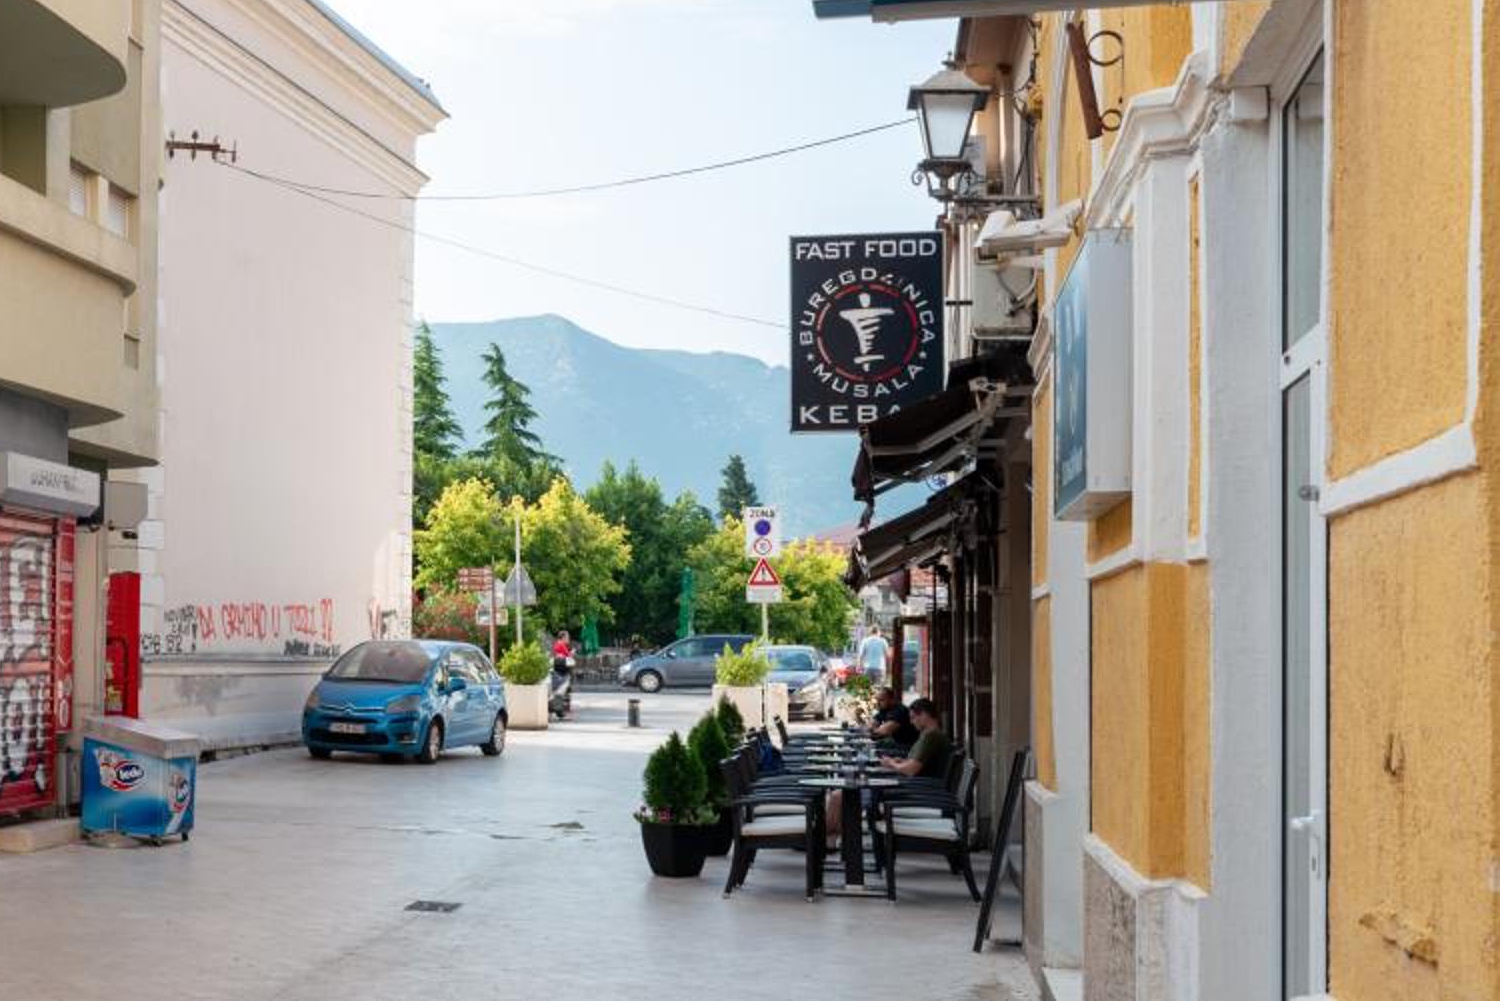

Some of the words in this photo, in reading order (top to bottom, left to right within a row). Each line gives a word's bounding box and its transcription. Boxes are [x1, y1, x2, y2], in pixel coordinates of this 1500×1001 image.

[795, 241, 856, 261] FAST
[864, 238, 937, 258] FOOD
[812, 362, 924, 399] MUSALA
